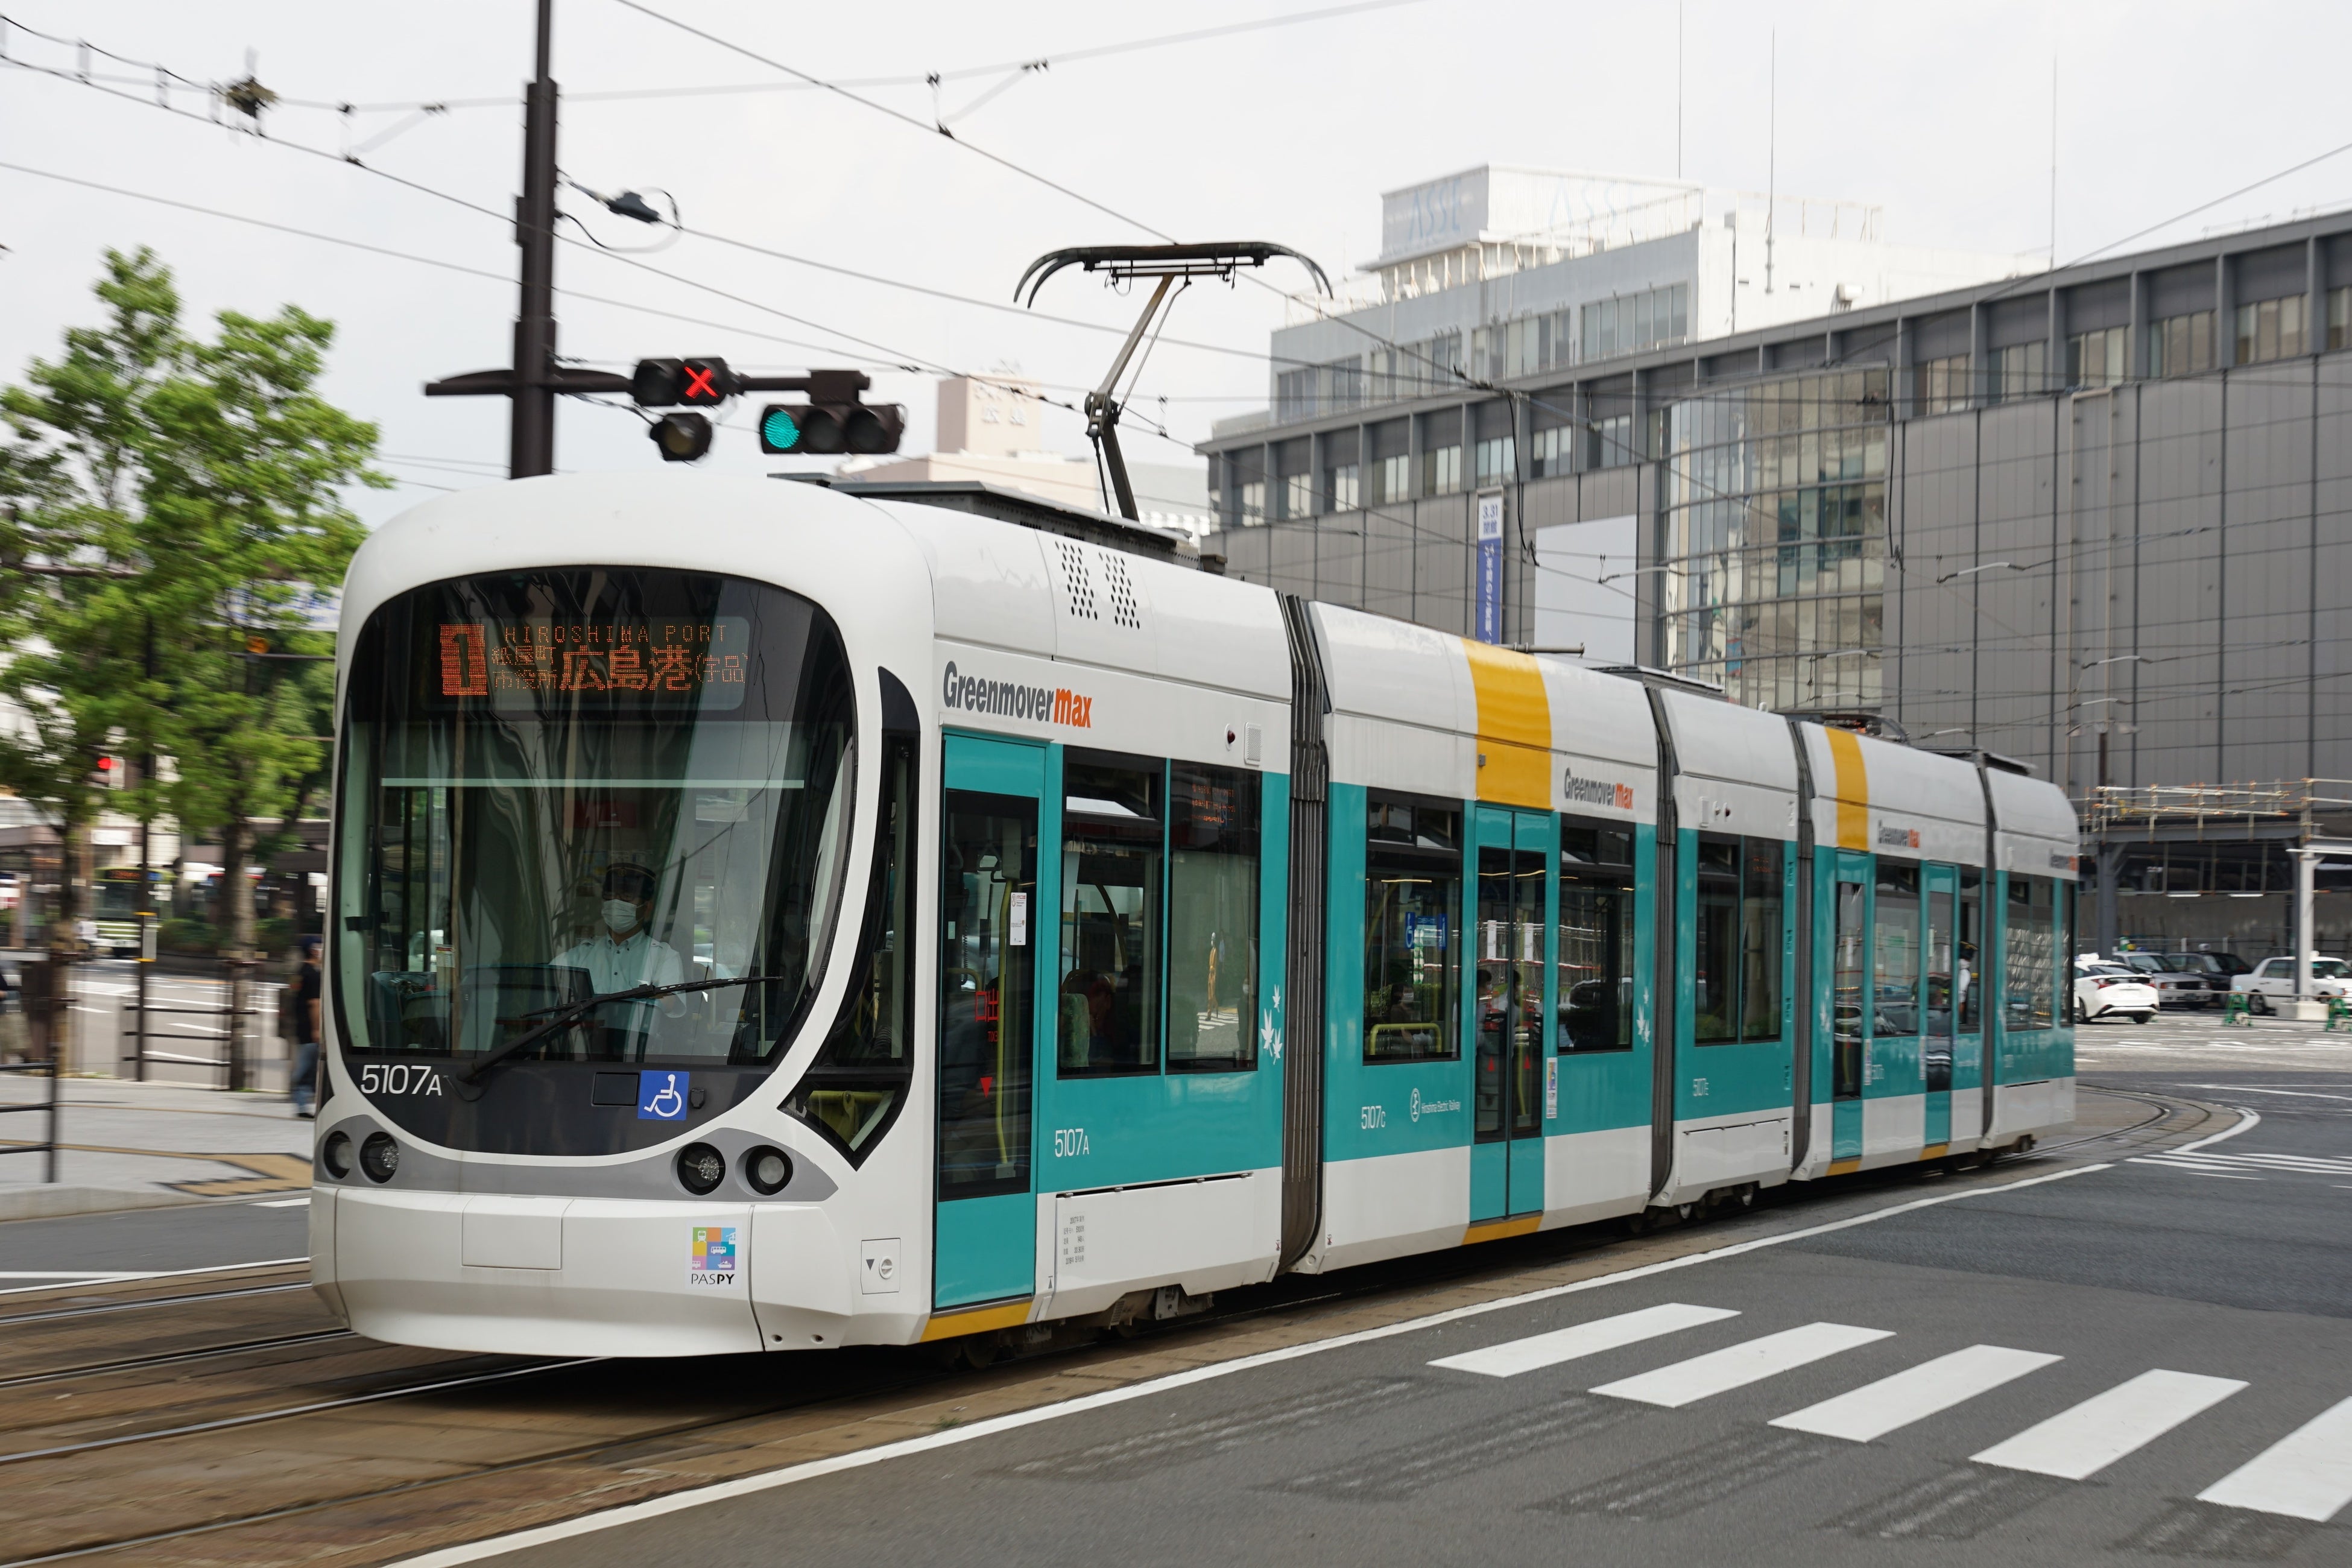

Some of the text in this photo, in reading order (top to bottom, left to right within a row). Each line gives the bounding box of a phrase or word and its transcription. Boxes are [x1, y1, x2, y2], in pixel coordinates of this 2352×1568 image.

[505, 625, 726, 643] HIROSHIMA PORT
[360, 1064, 442, 1096] 5107A
[1055, 1128, 1090, 1158] 5107A
[691, 1273, 735, 1285] PASPY
